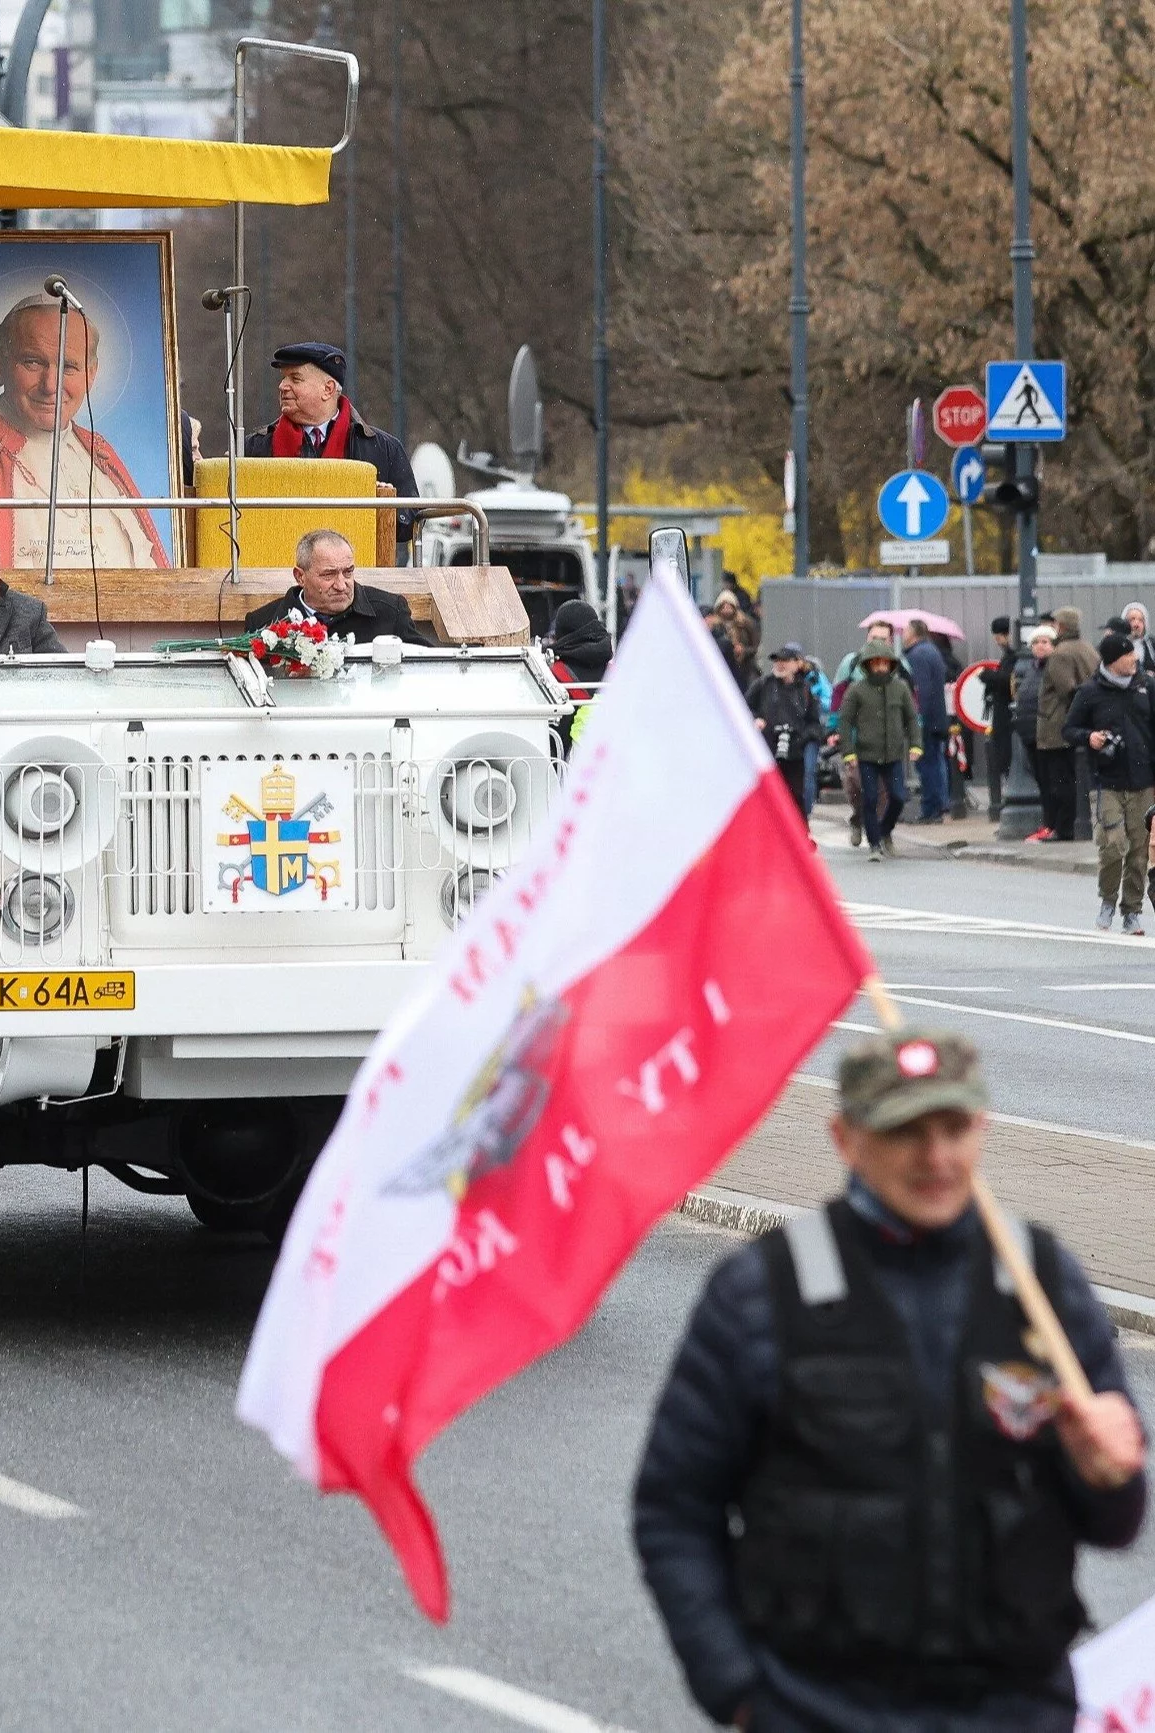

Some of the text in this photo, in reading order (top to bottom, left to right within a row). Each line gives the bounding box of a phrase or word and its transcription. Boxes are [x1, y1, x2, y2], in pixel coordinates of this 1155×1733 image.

[939, 405, 983, 429] STOP
[282, 856, 303, 889] M
[33, 976, 89, 1006] 64A
